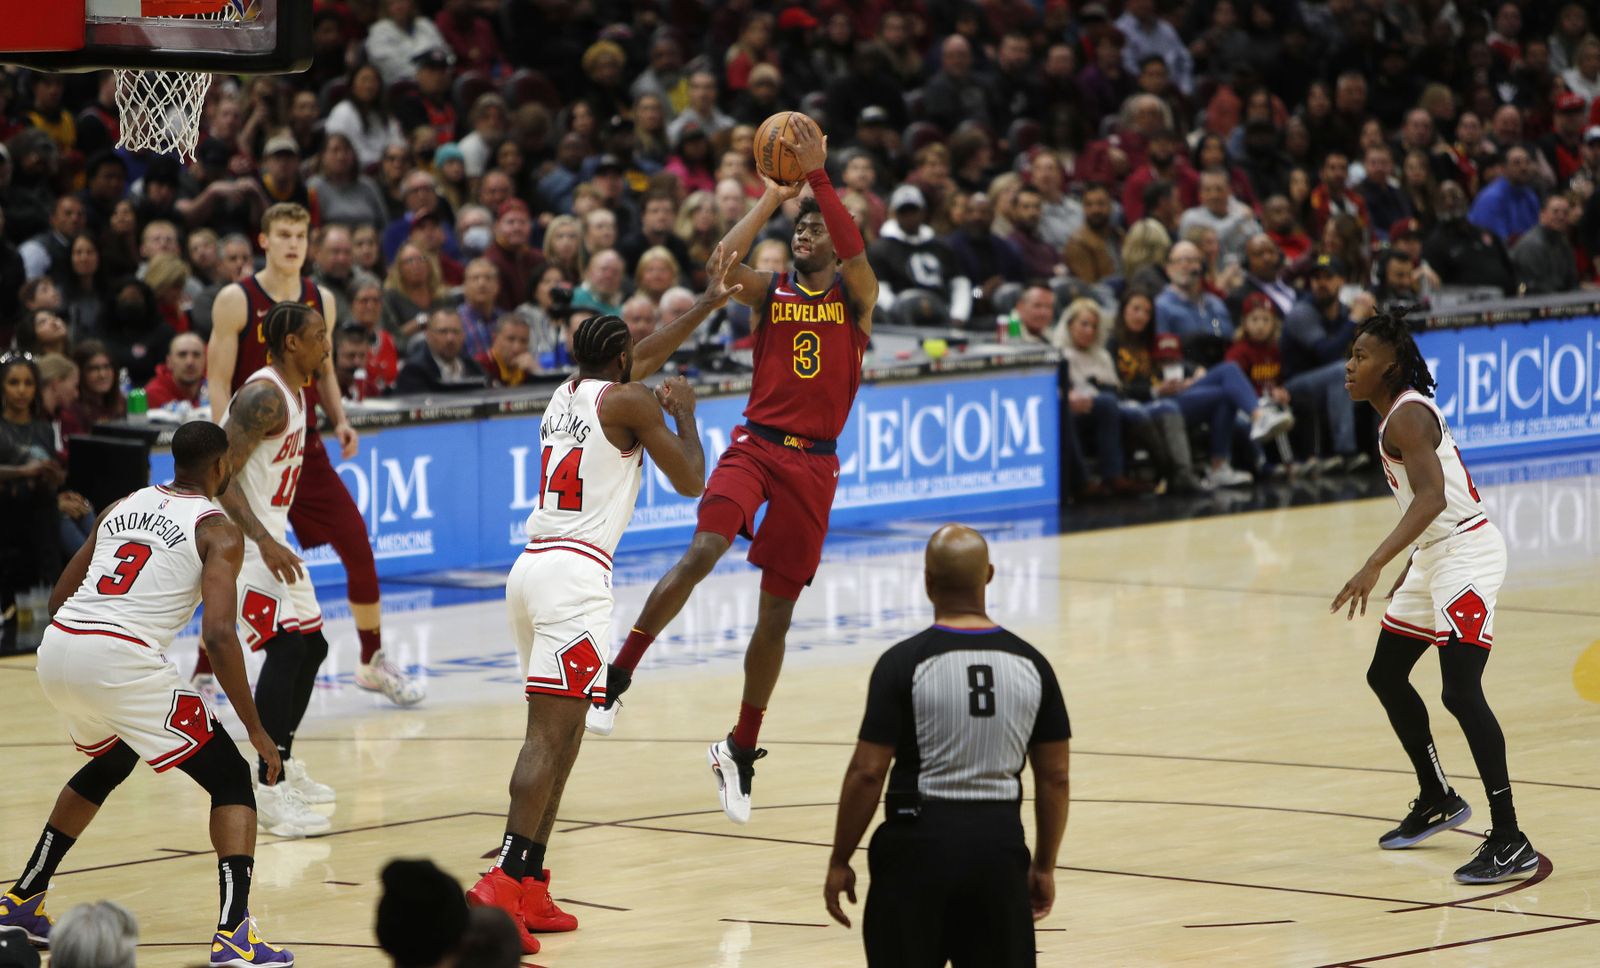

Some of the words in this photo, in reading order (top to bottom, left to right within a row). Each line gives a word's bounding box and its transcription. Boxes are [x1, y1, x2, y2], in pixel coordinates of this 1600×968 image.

[771, 301, 845, 325] CLEVELAND
[793, 330, 821, 379] 3
[1426, 342, 1600, 419] LECO
[540, 412, 591, 444] WILLIAMS
[271, 465, 301, 507] 11
[103, 512, 187, 549] THOMPSON
[377, 530, 432, 552] MEDICINE
[96, 541, 153, 596] 3
[967, 664, 996, 718] 8
